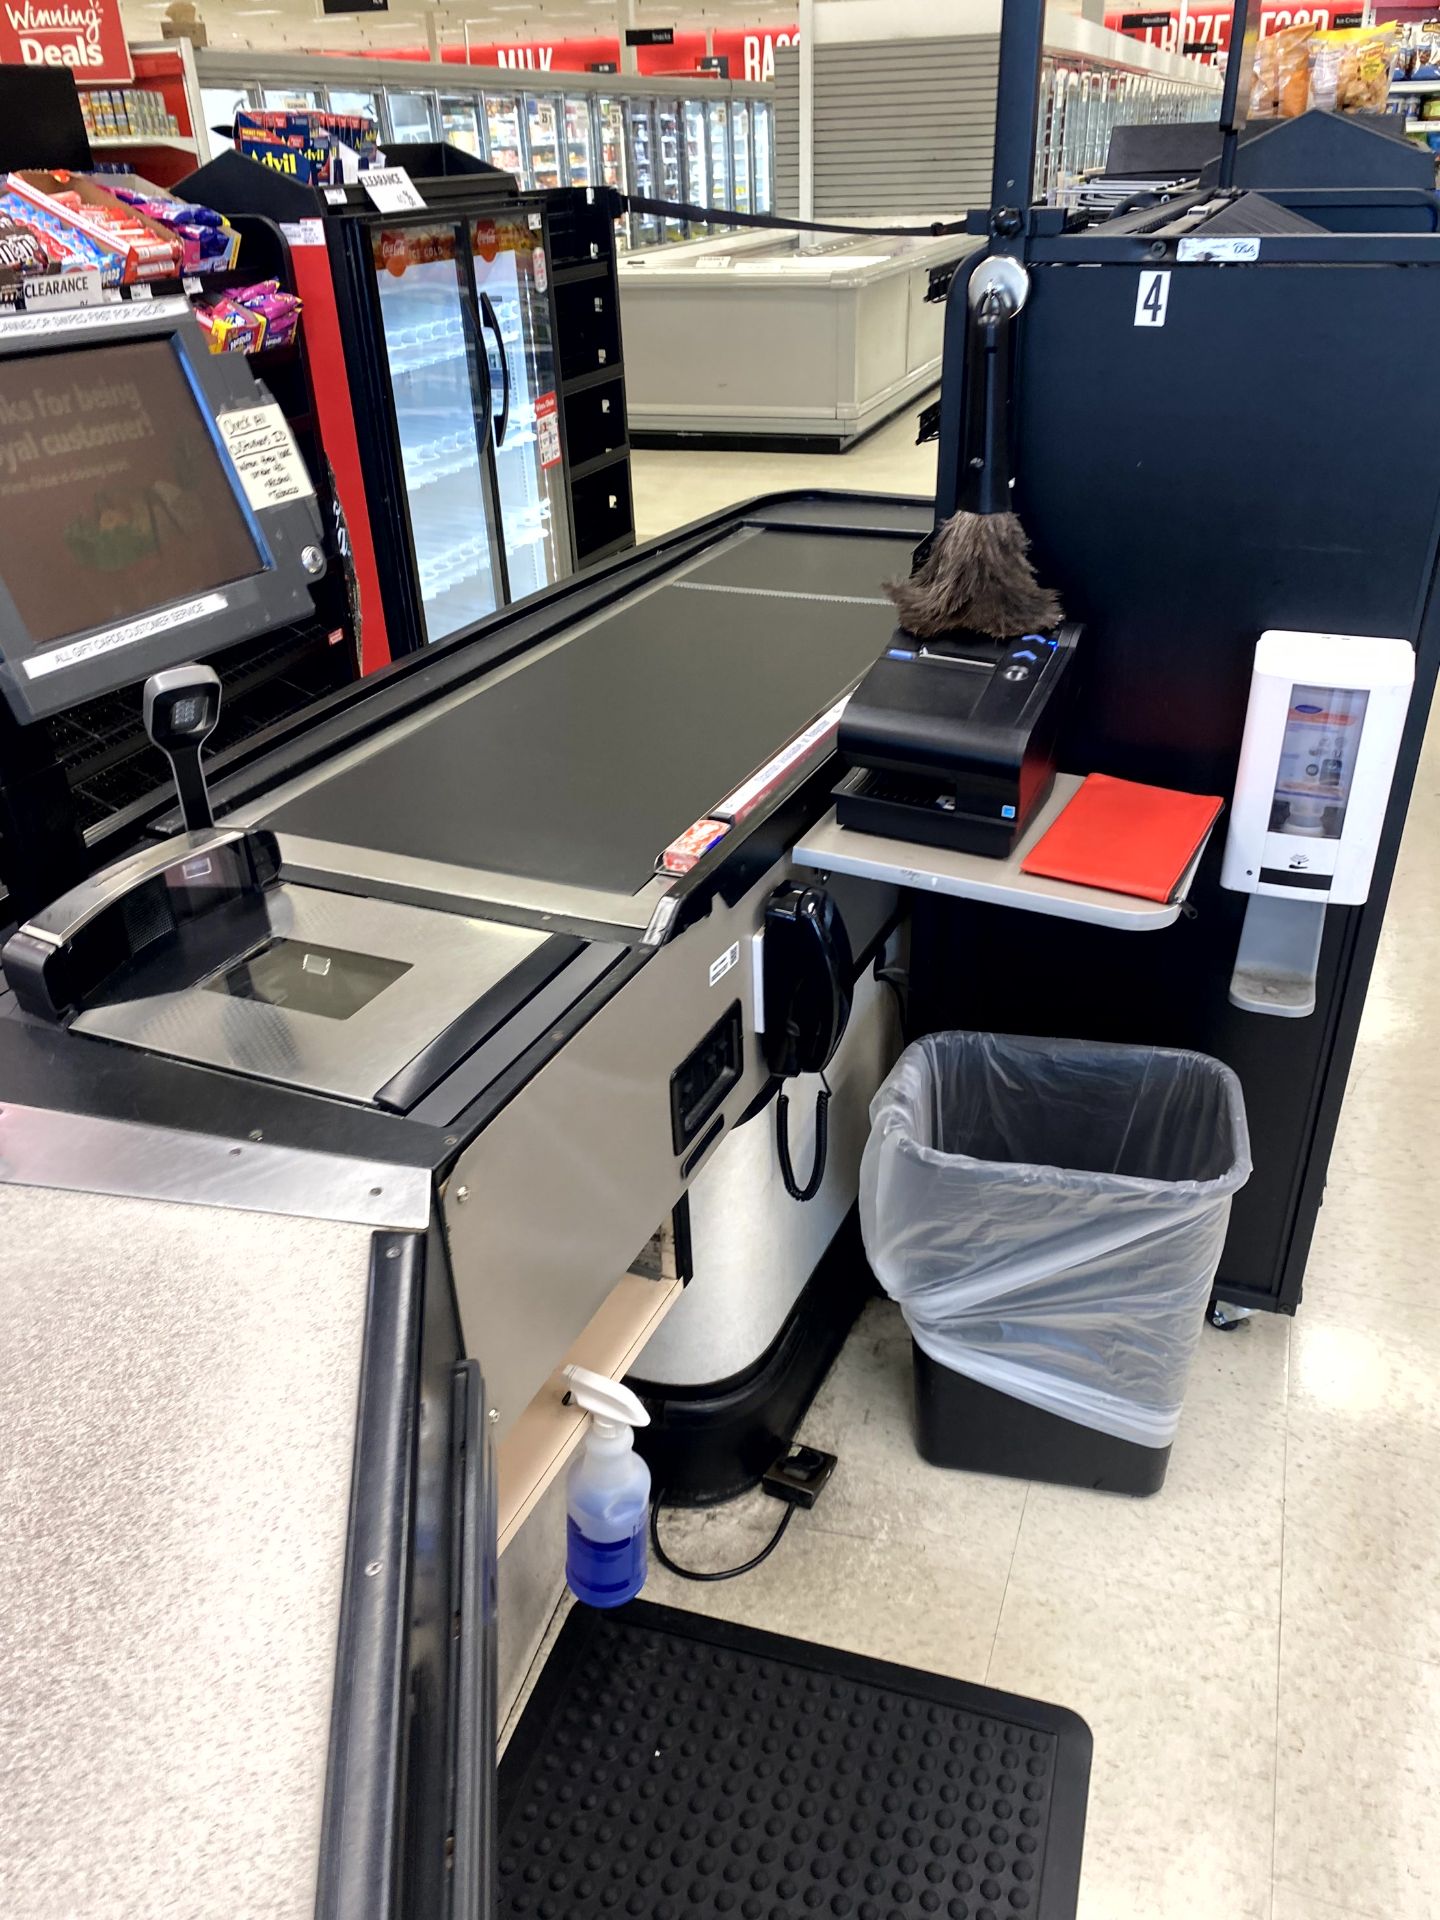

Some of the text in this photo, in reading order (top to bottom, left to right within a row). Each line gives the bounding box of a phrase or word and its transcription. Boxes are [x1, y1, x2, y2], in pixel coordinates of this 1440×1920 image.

[5, 0, 102, 44] Winning
[20, 35, 104, 66] Deals
[24, 276, 89, 299] CLEARANCE
[1143, 274, 1163, 322] 4
[32, 388, 72, 417] for
[54, 651, 73, 665] ALL
[72, 641, 94, 659] GIFT
[124, 614, 169, 640] CUSTOMER
[169, 602, 206, 623] SERVICE
